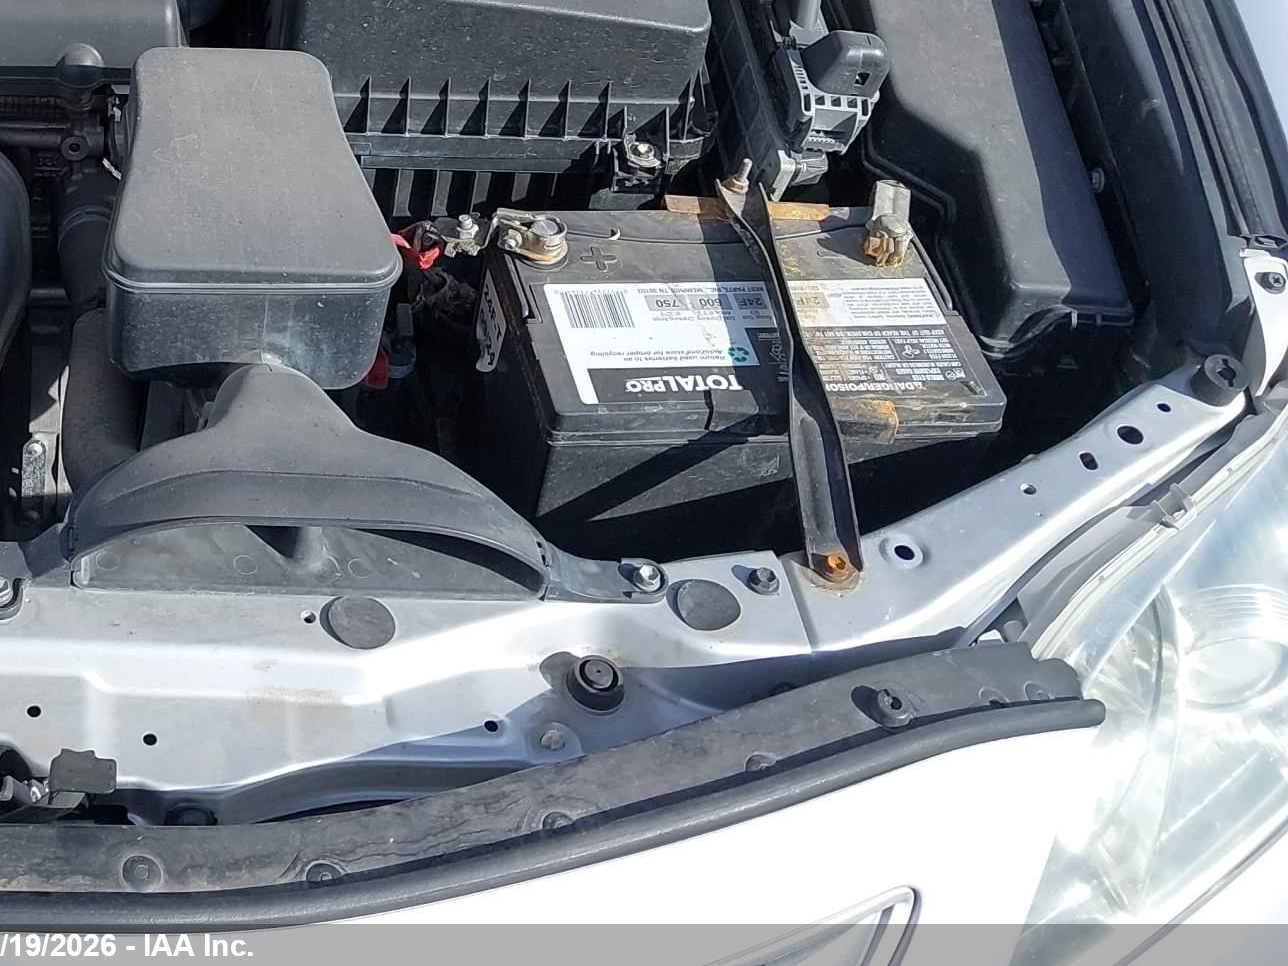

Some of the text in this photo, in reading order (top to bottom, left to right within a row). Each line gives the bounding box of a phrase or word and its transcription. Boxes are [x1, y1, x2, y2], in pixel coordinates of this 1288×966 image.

[655, 299, 680, 307] 750
[698, 298, 722, 307] 600
[739, 297, 763, 307] 24F
[625, 375, 744, 393] TOTALPRO
